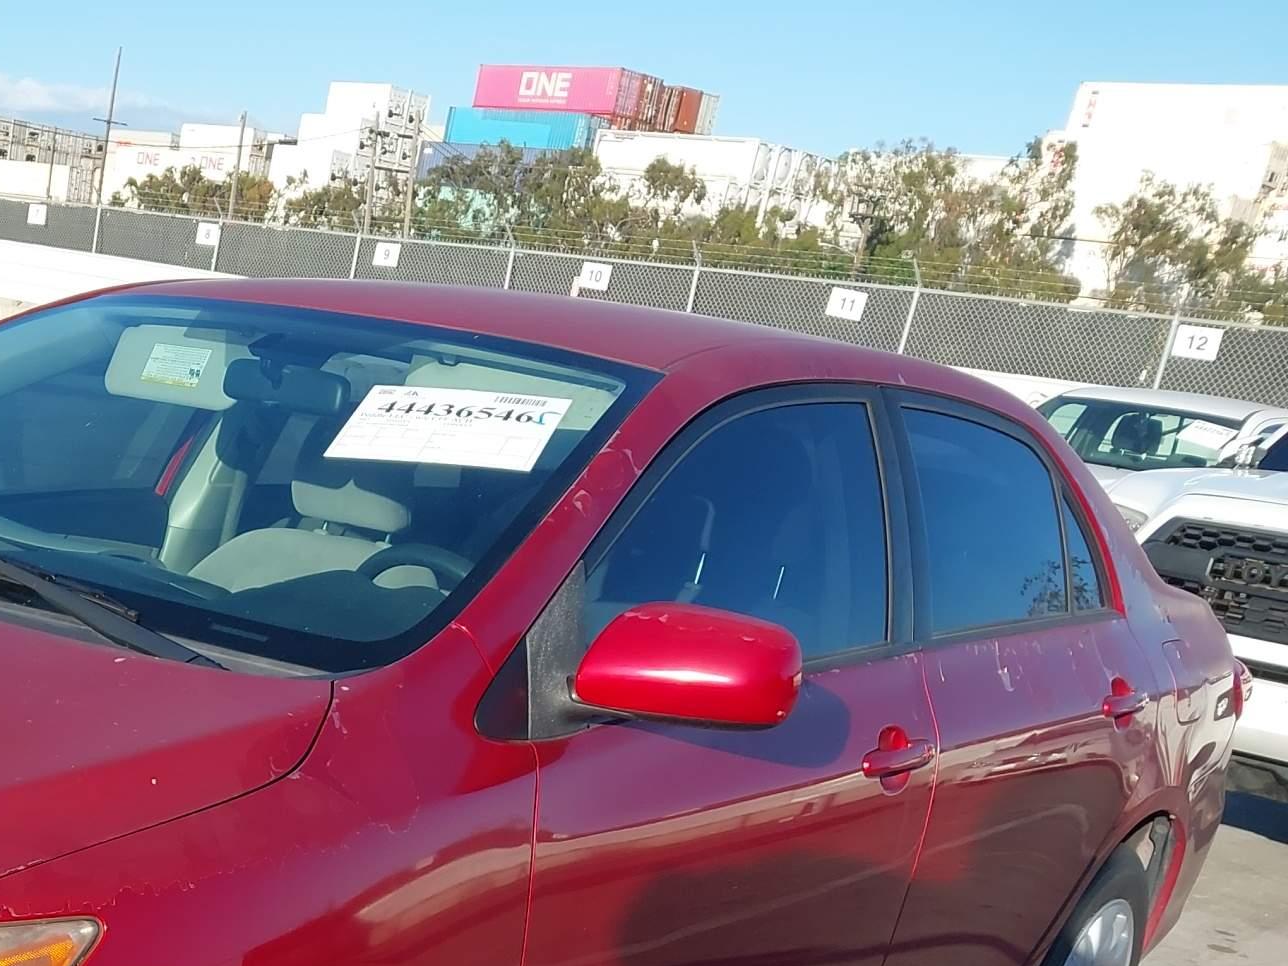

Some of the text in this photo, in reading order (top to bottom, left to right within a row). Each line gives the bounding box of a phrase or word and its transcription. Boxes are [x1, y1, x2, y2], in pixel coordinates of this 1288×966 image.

[518, 71, 573, 97] ONE
[137, 151, 161, 167] ONE
[200, 155, 225, 171] ONE
[382, 248, 392, 261] 9
[587, 269, 604, 284] 10
[840, 296, 857, 313] 11
[1185, 334, 1210, 351] 12
[377, 400, 534, 425] 44436546
